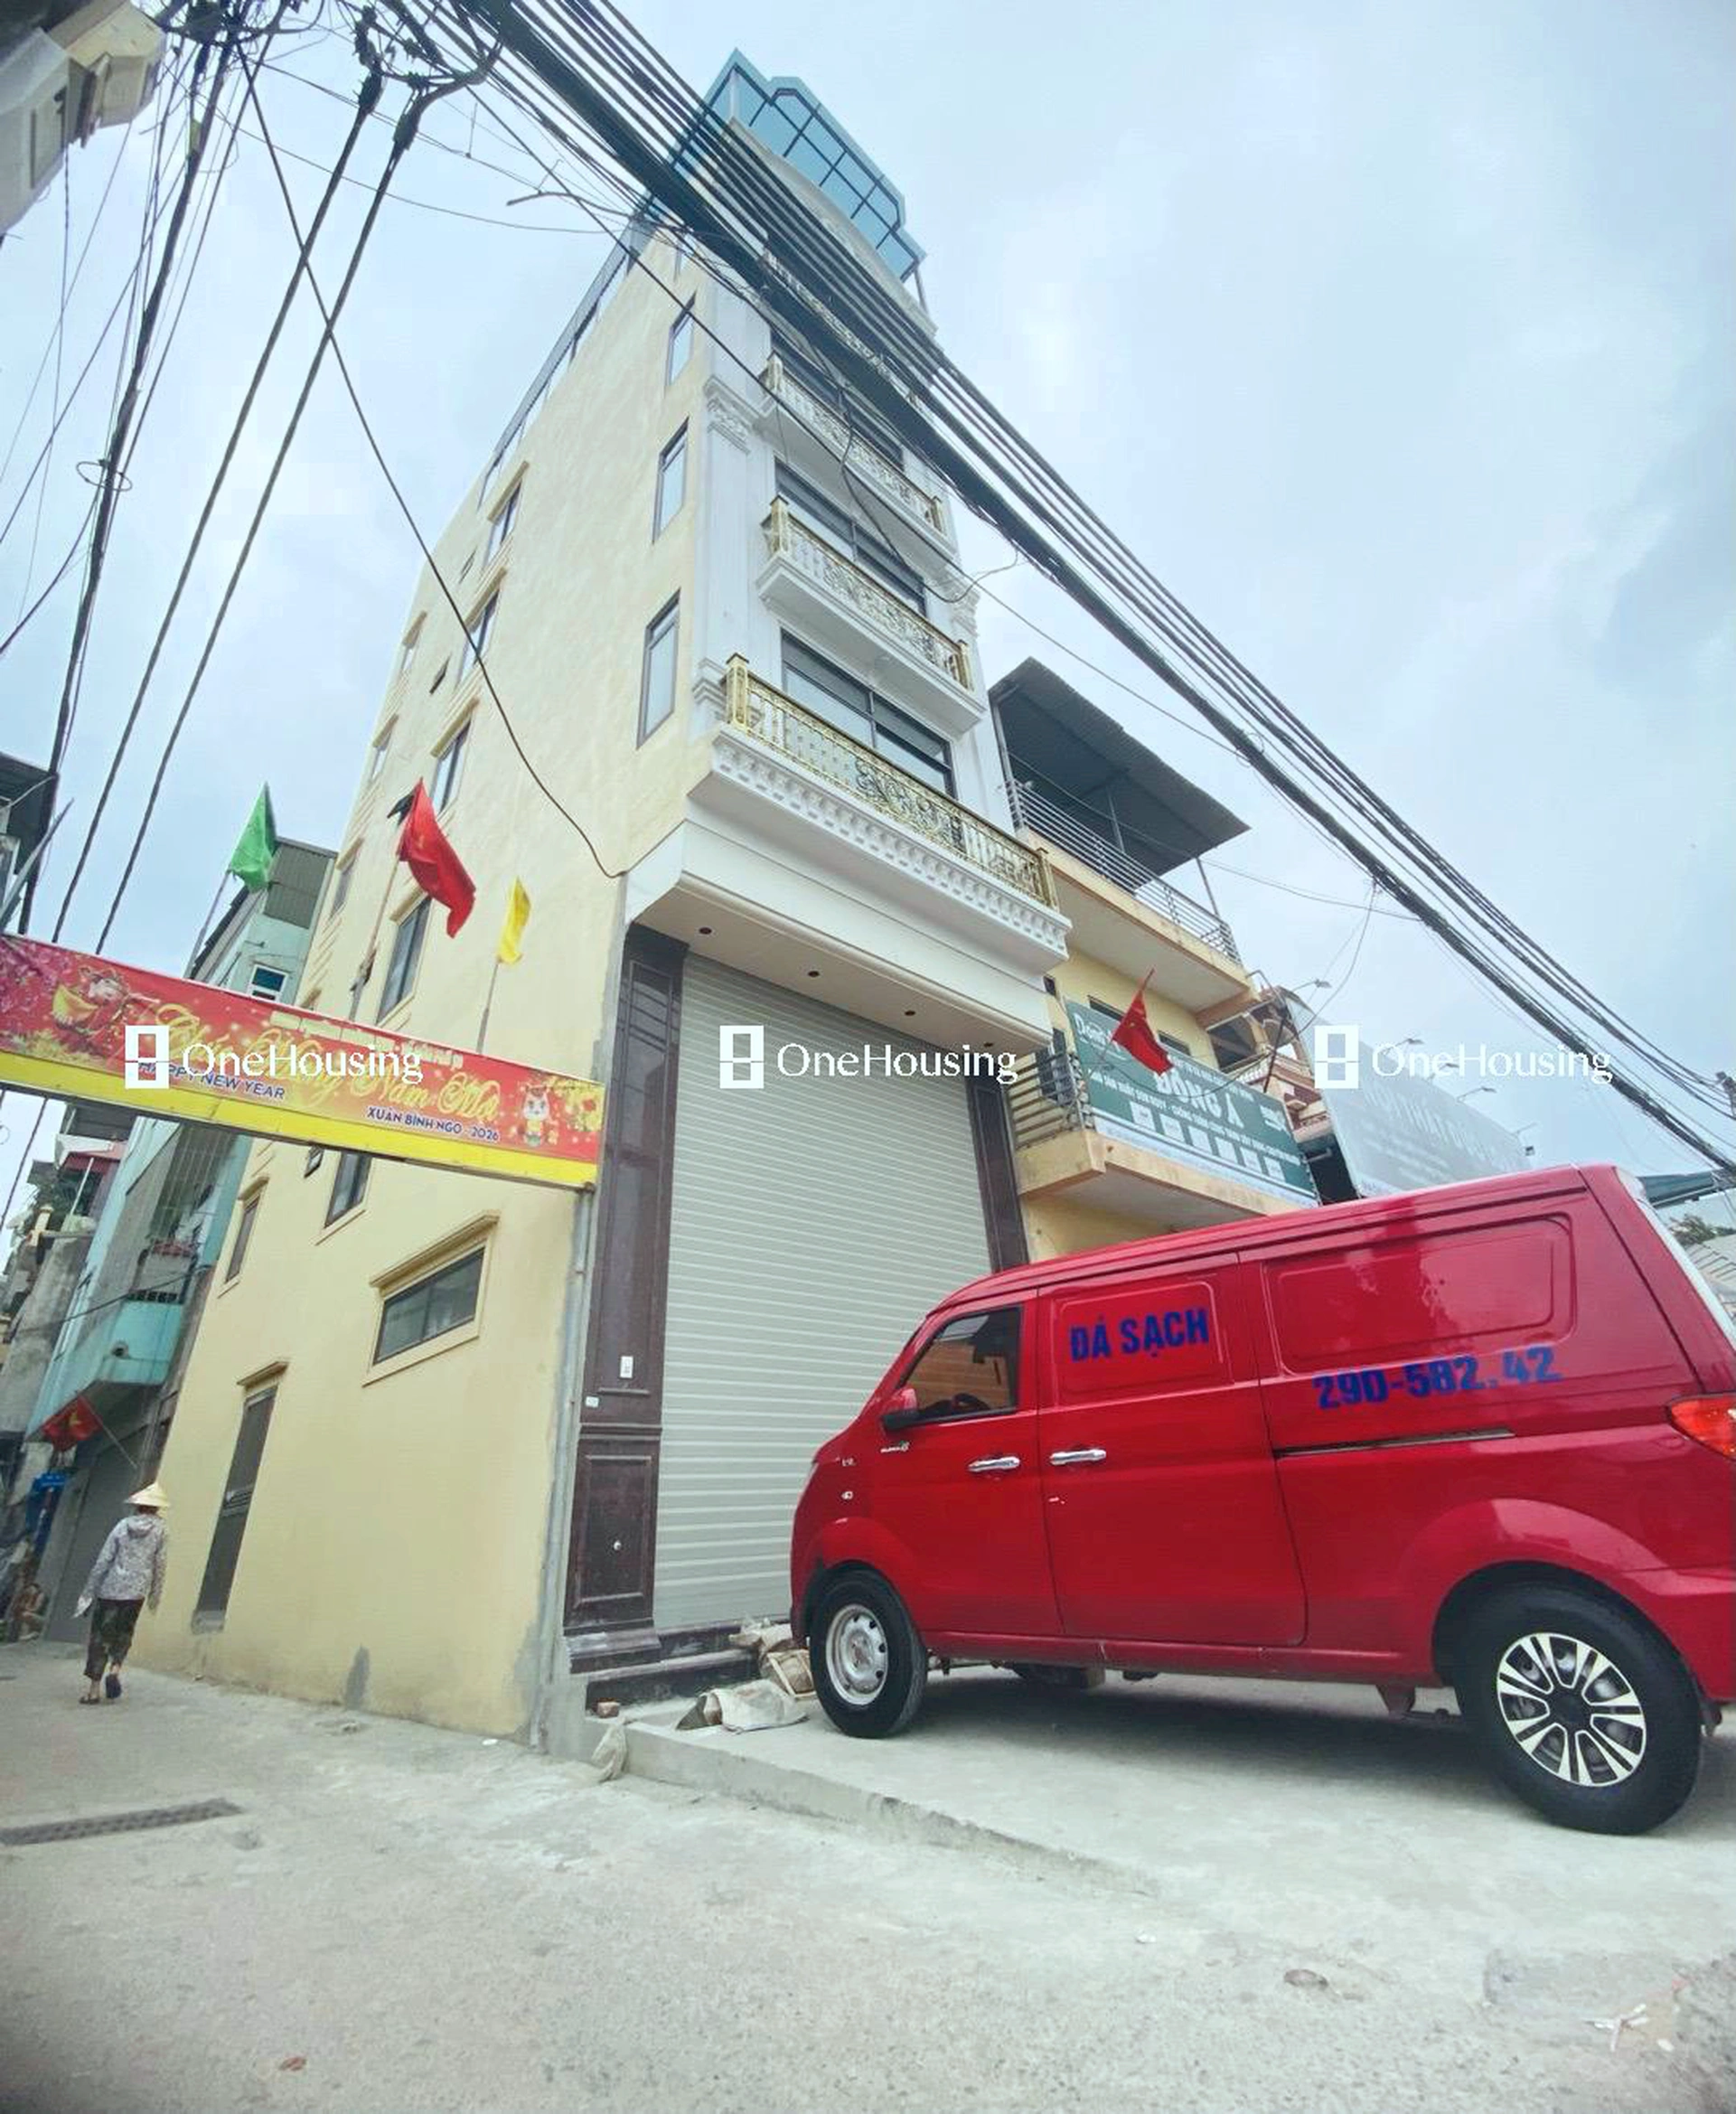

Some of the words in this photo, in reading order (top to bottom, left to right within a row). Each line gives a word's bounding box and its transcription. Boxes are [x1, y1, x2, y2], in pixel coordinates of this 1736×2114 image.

[201, 1069, 241, 1090] NEW
[245, 1080, 286, 1100] YEAR
[470, 1125, 499, 1141] 2026
